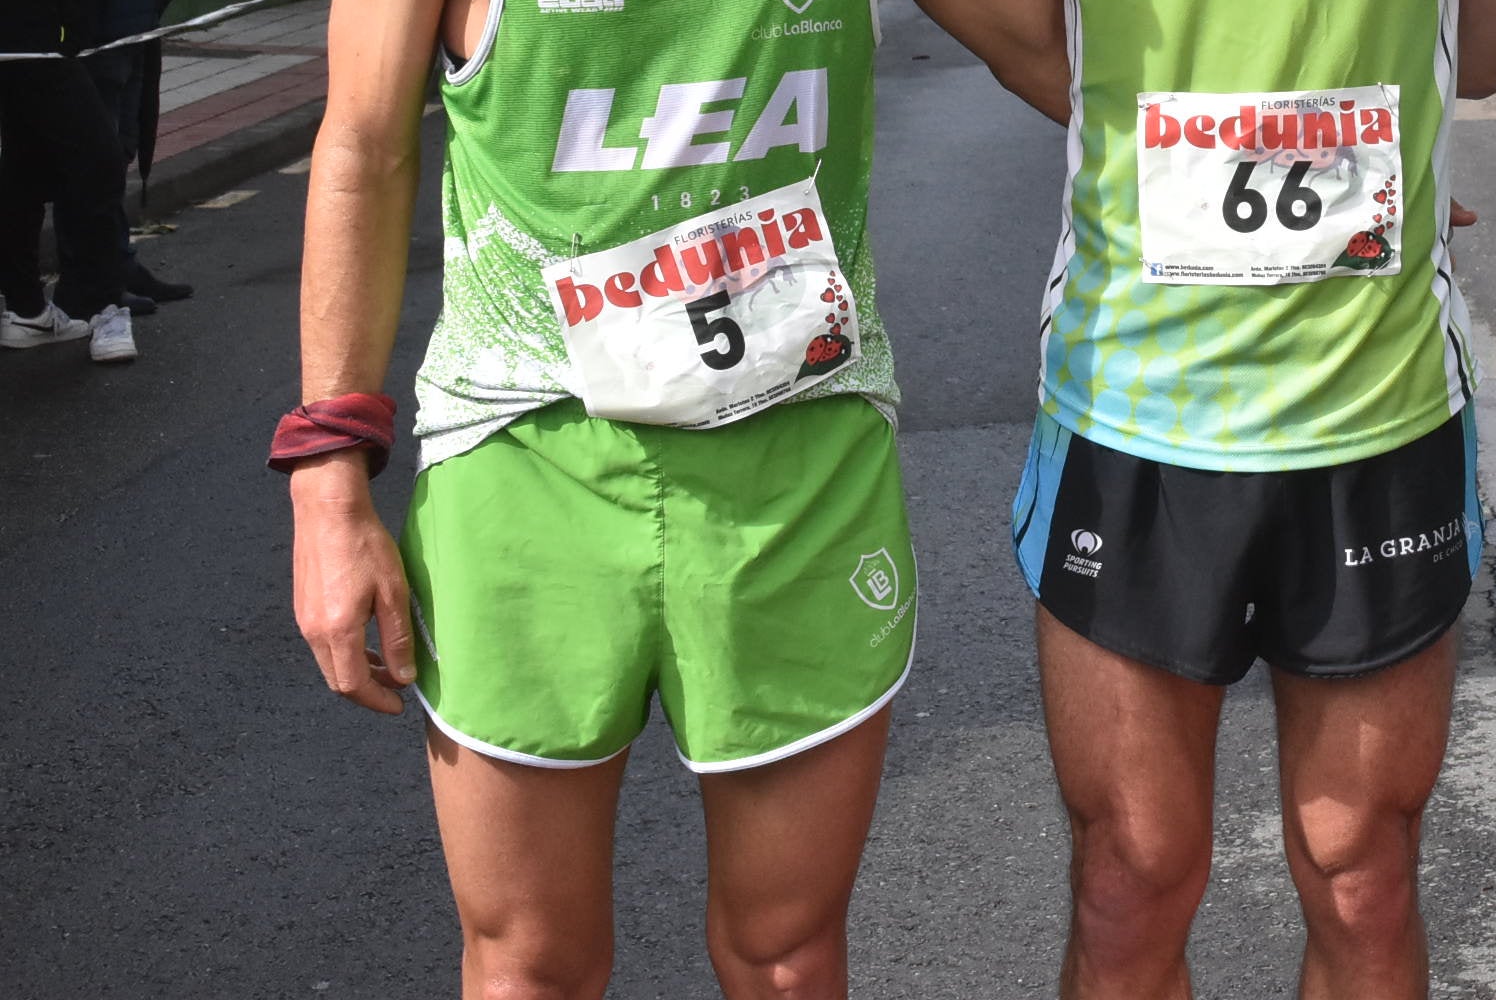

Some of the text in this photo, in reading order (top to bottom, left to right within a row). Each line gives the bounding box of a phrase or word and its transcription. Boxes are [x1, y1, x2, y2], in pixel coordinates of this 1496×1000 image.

[751, 18, 842, 40] club LaBlanca
[551, 67, 829, 172] LEA
[1144, 99, 1394, 150] bedunia
[1261, 96, 1336, 111] FLORISTERÍAS
[1222, 160, 1323, 234] 66
[673, 210, 753, 245] FLORISTERÍAS
[558, 207, 824, 327] bedunia
[684, 292, 747, 371] 5
[1065, 553, 1103, 570] SPORTING
[1344, 518, 1461, 566] LA GRANJA
[1063, 561, 1099, 578] PURSUITS
